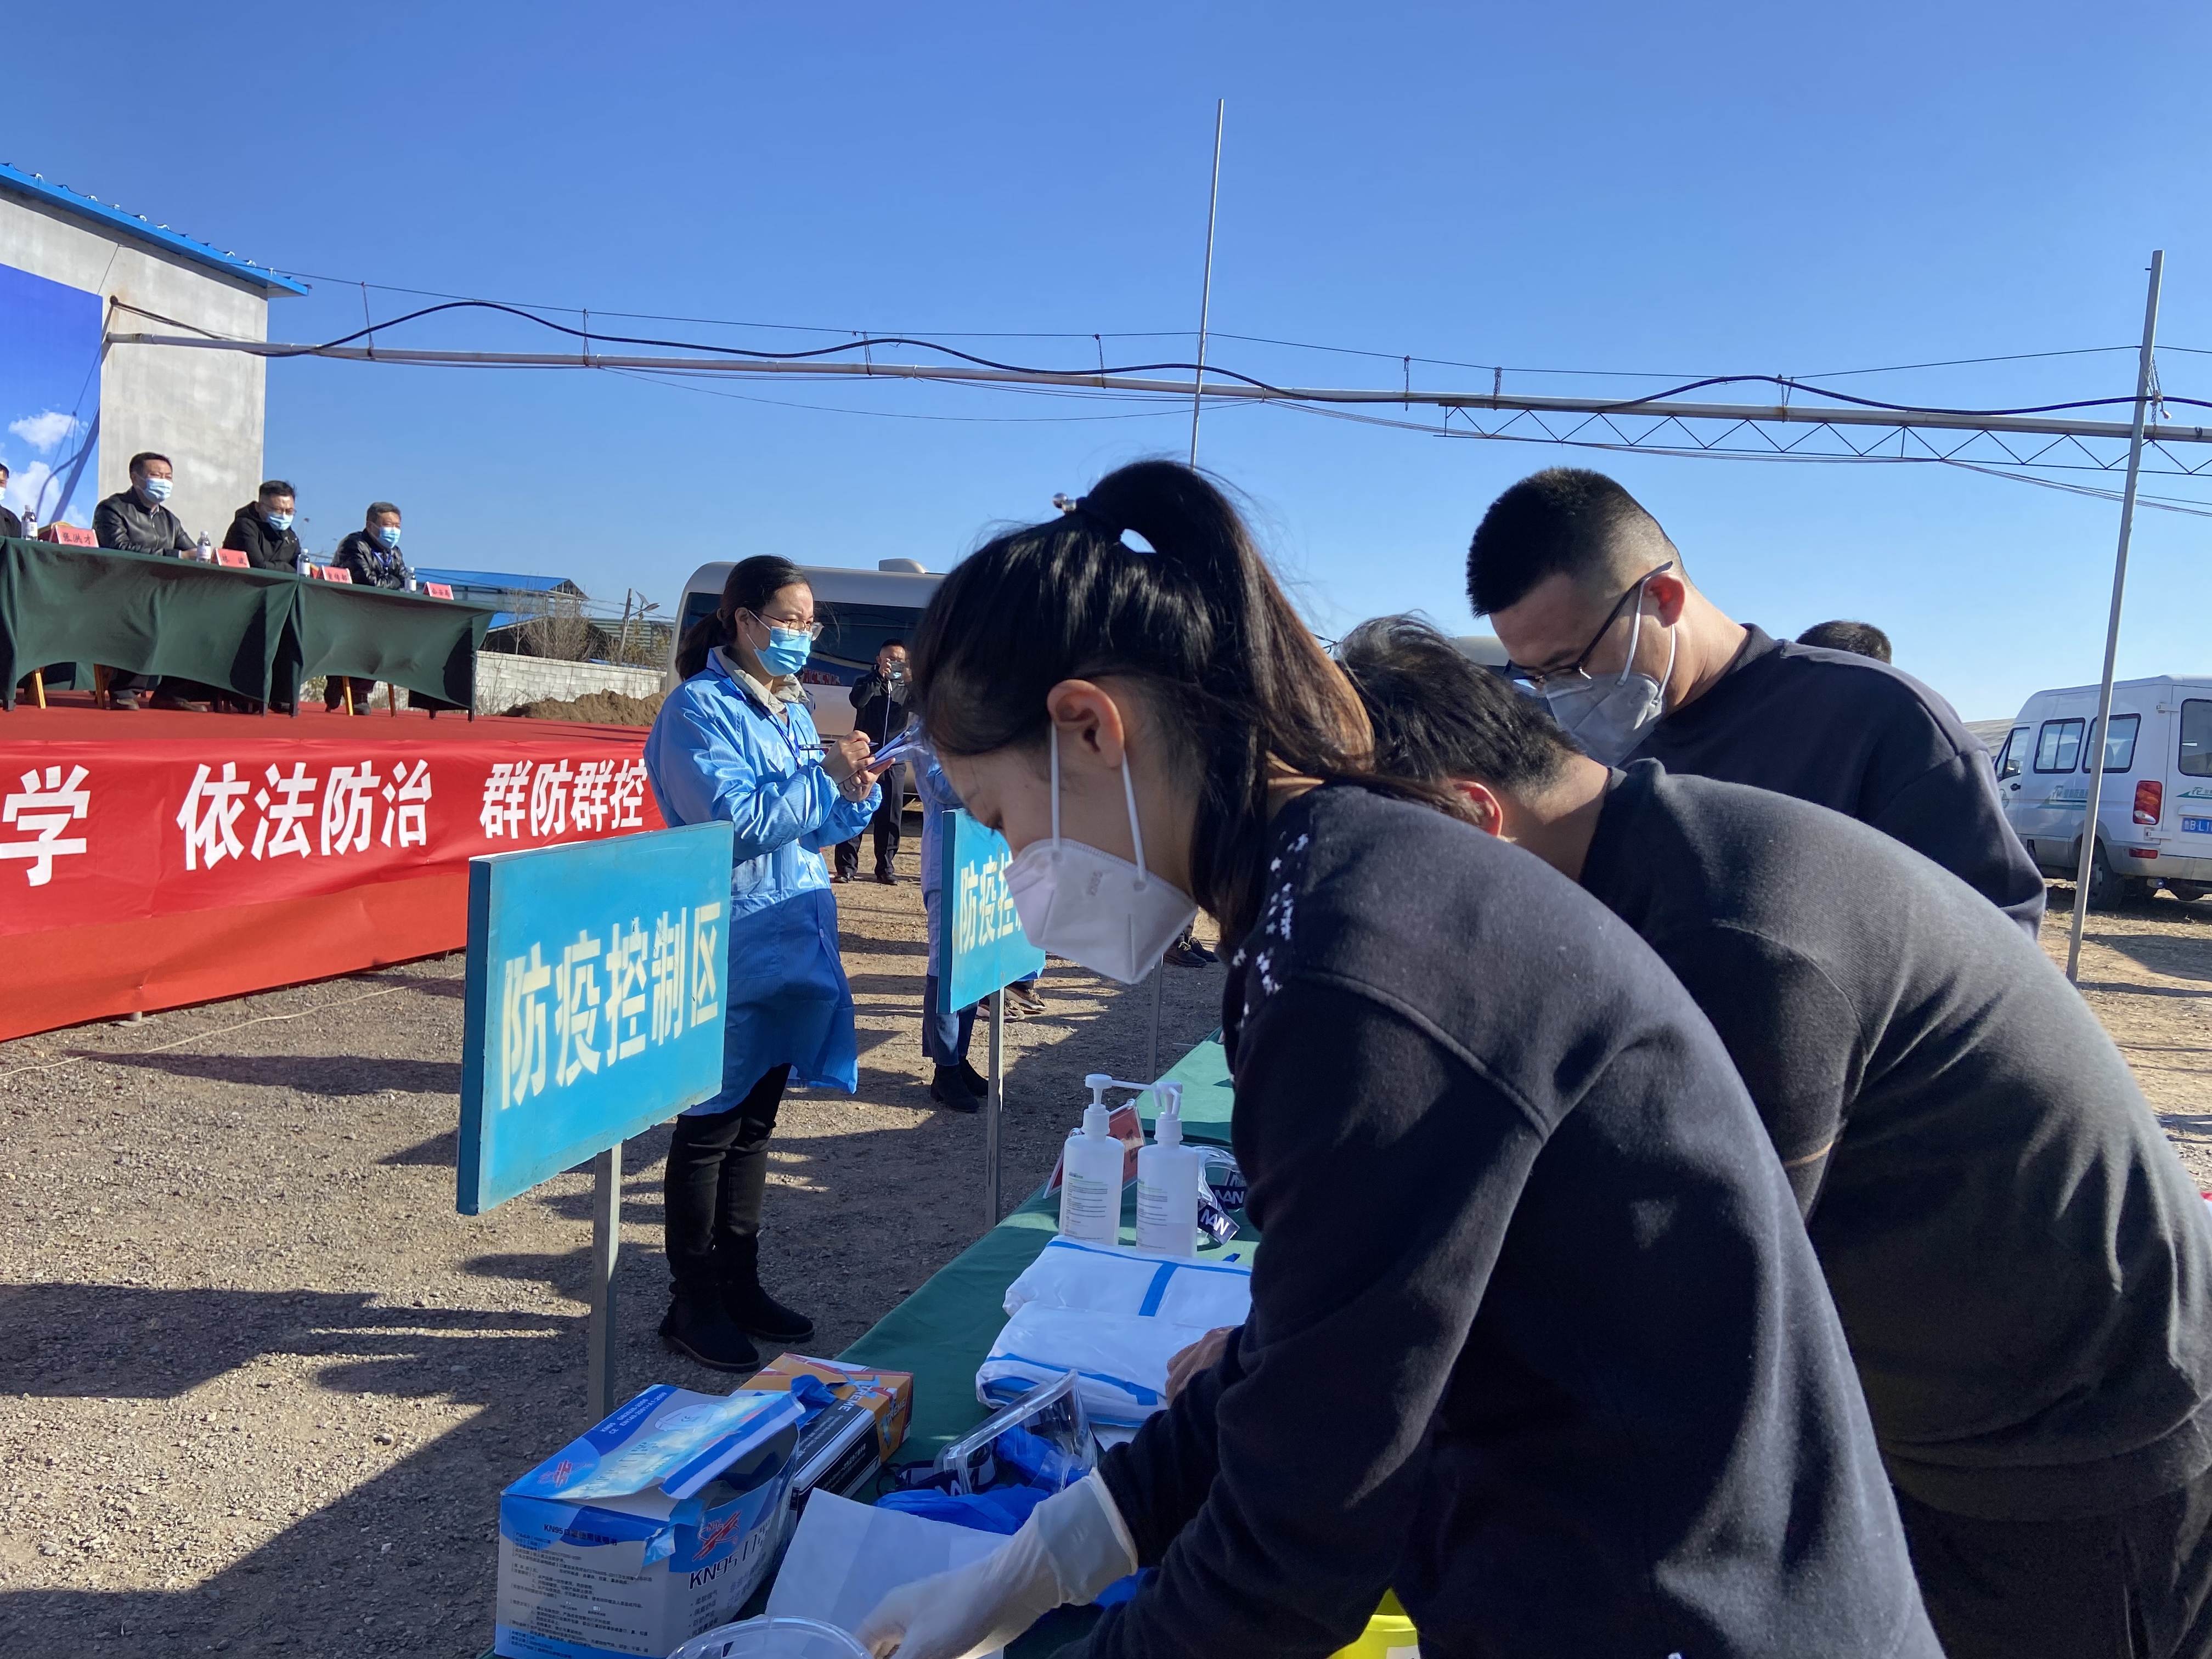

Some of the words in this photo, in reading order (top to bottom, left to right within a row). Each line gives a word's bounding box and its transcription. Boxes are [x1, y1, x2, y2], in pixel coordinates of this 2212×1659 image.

[0, 765, 90, 887] 学
[177, 759, 432, 871] 依法防治
[479, 758, 647, 839] 群防群控
[959, 851, 1024, 955] 防疫控
[501, 901, 721, 1110] 防疫控制区
